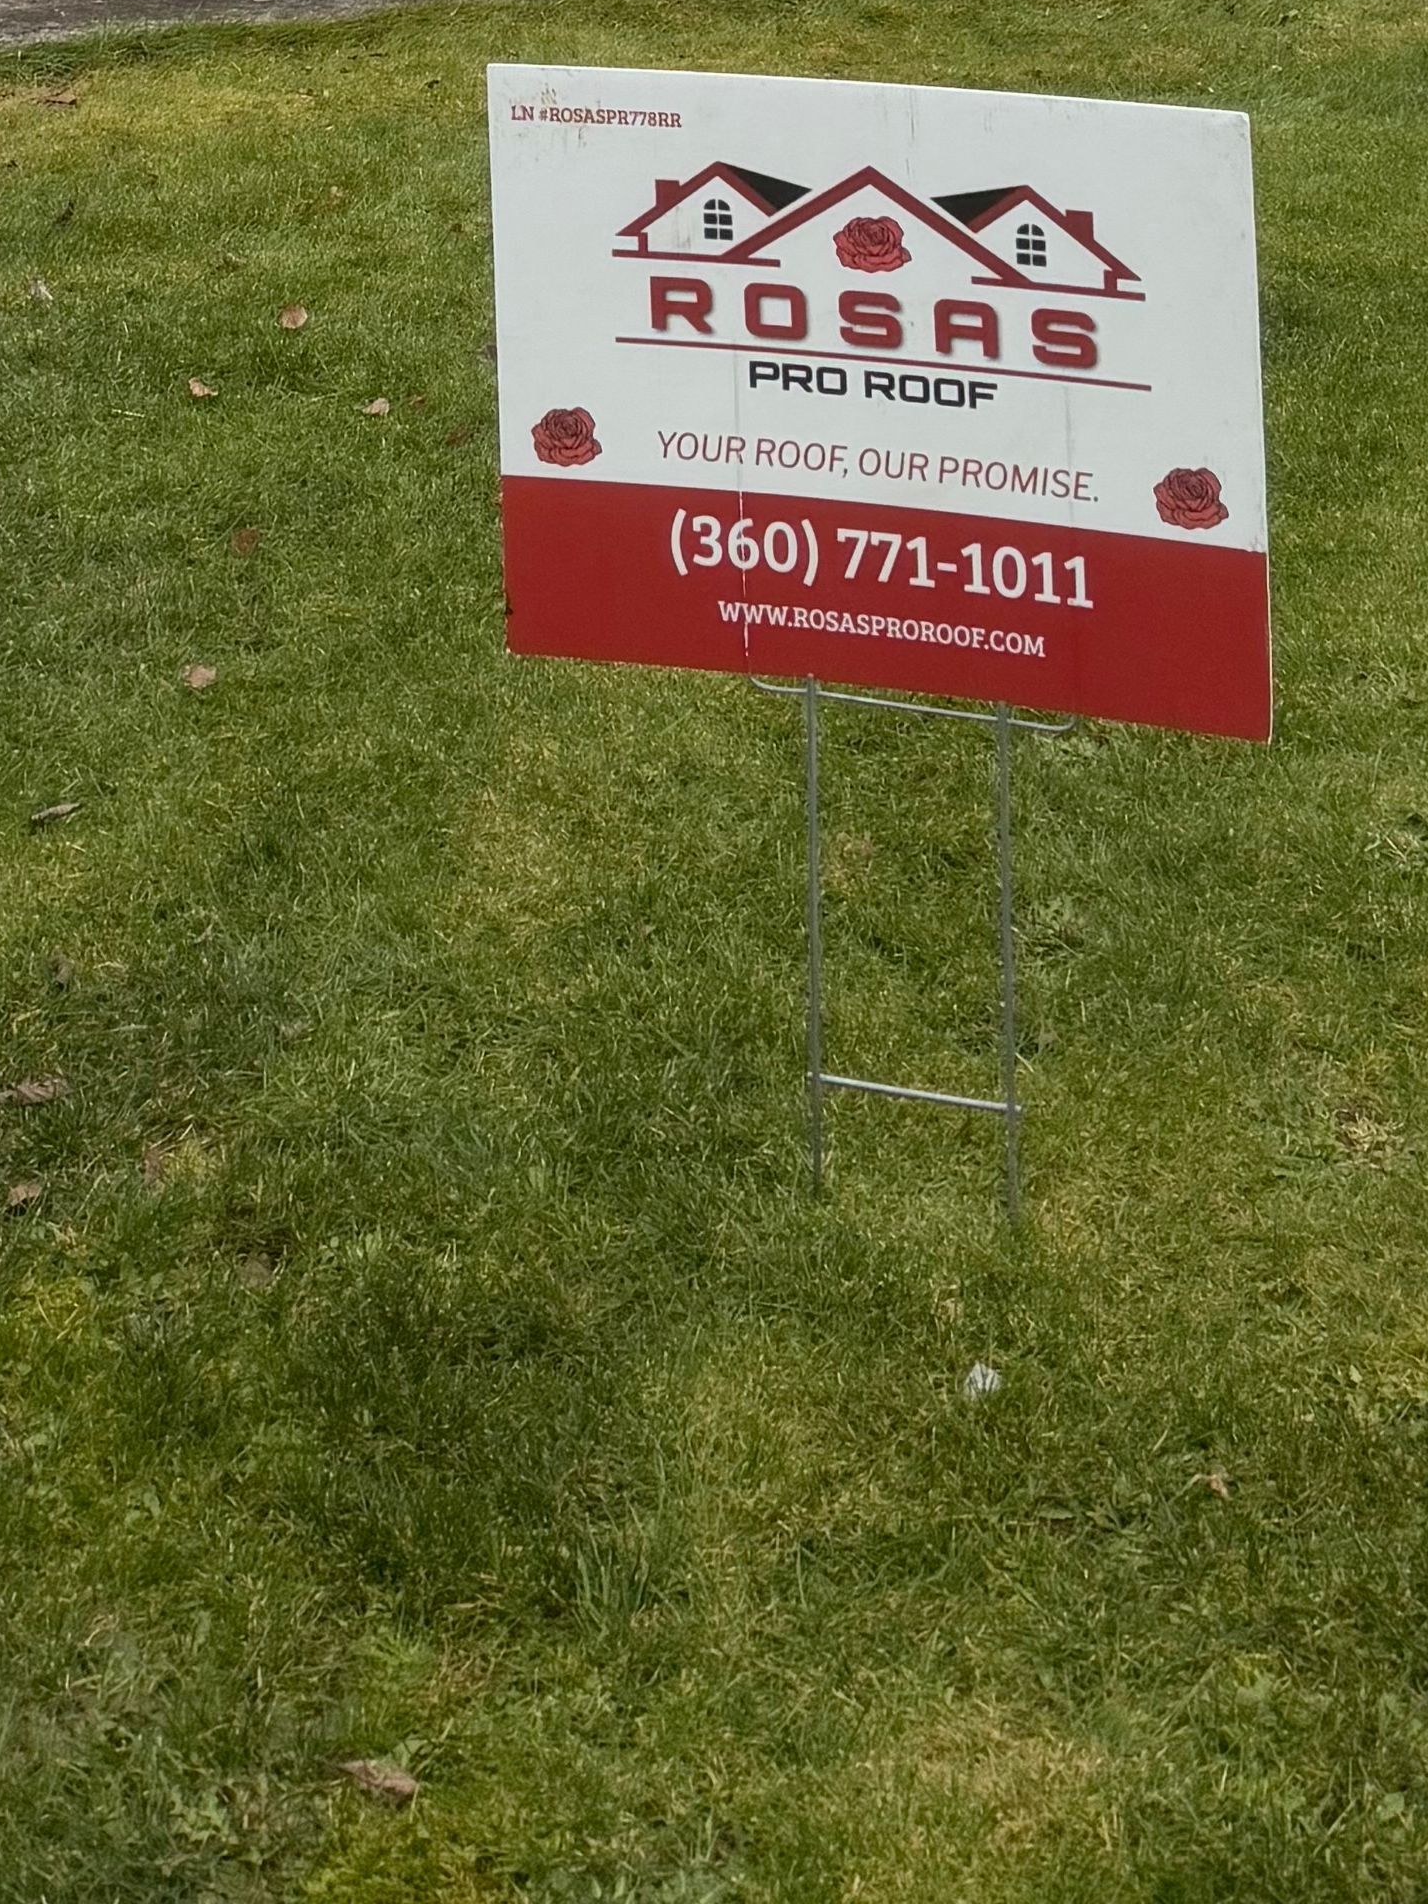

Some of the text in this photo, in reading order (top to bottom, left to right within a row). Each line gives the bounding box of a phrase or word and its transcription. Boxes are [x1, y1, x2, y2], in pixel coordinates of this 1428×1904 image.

[510, 105, 535, 122] LN
[648, 275, 1099, 371] ROSAS
[748, 360, 999, 409] PRO ROOF
[657, 430, 1100, 503] YOUR ROOF, OUR PROMISE.
[669, 507, 1095, 610] (360) 771-1011
[717, 600, 1047, 658] WWW.ROSASPROROOF.COM
